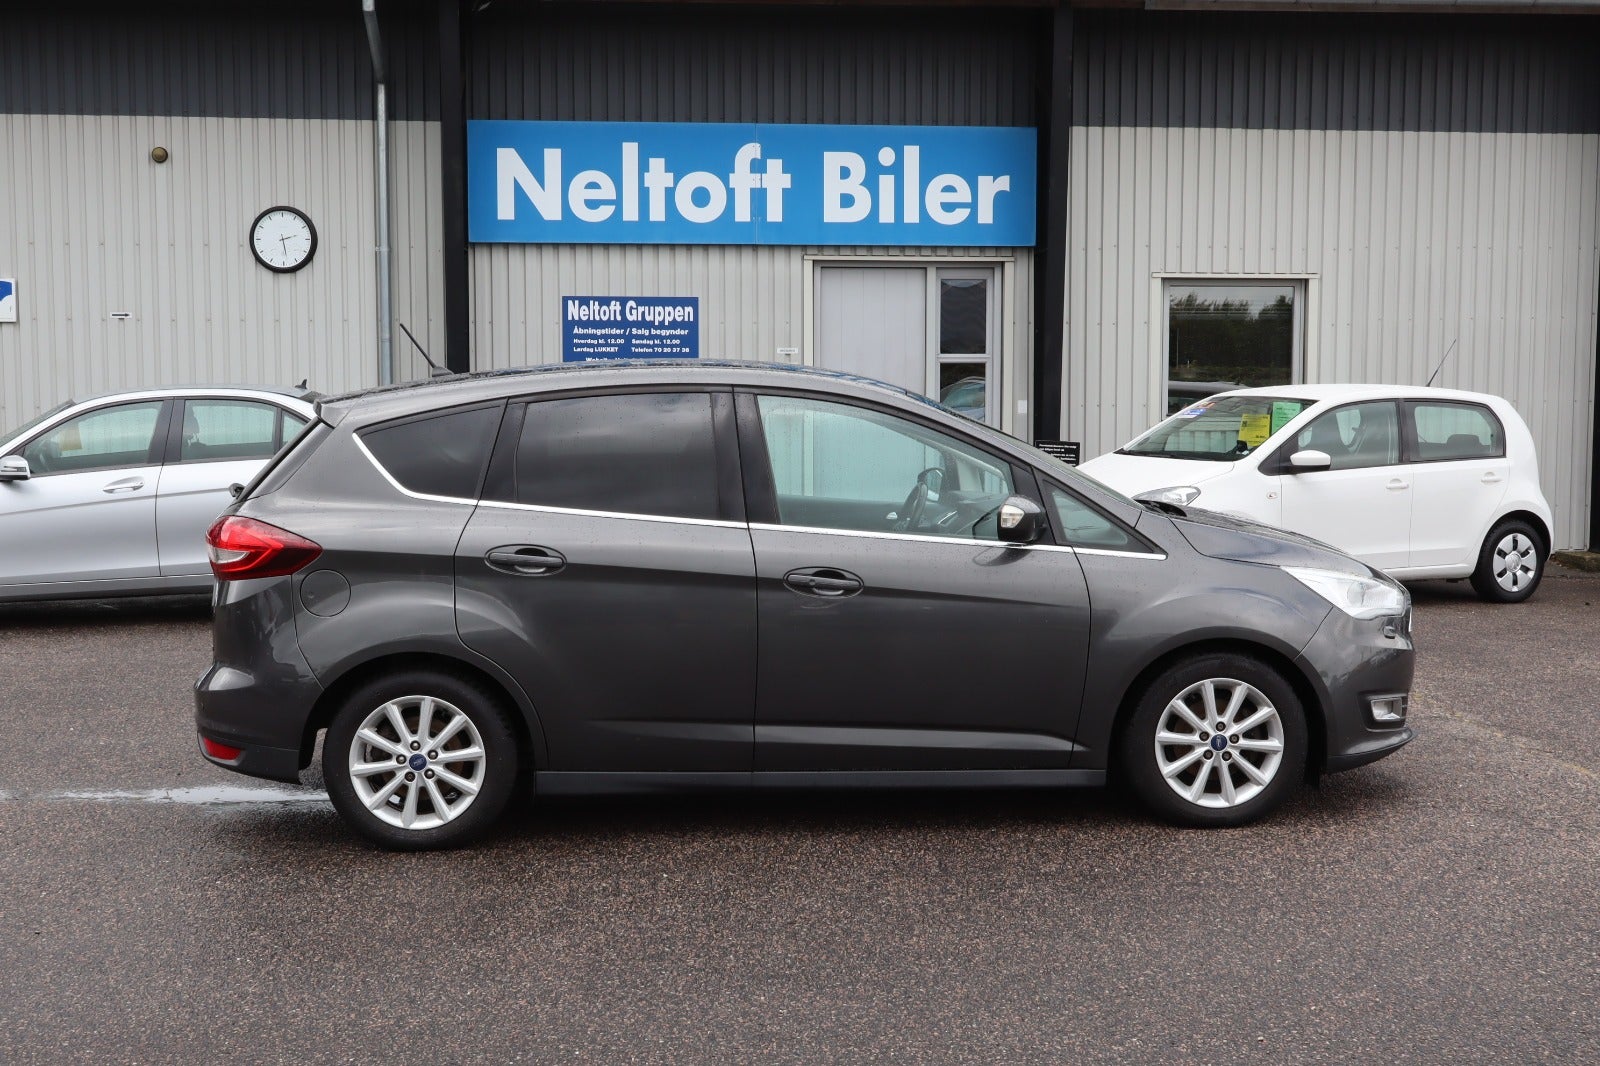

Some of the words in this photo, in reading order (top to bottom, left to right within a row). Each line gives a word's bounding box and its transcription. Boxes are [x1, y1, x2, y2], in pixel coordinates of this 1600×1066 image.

[497, 141, 791, 223] Neltoft
[823, 145, 1010, 225] Biler
[567, 299, 621, 321] Neltoft
[625, 300, 694, 326] Gruppen
[573, 325, 624, 336] Åbningstider
[631, 328, 650, 336] Salg
[650, 328, 689, 336] begynder
